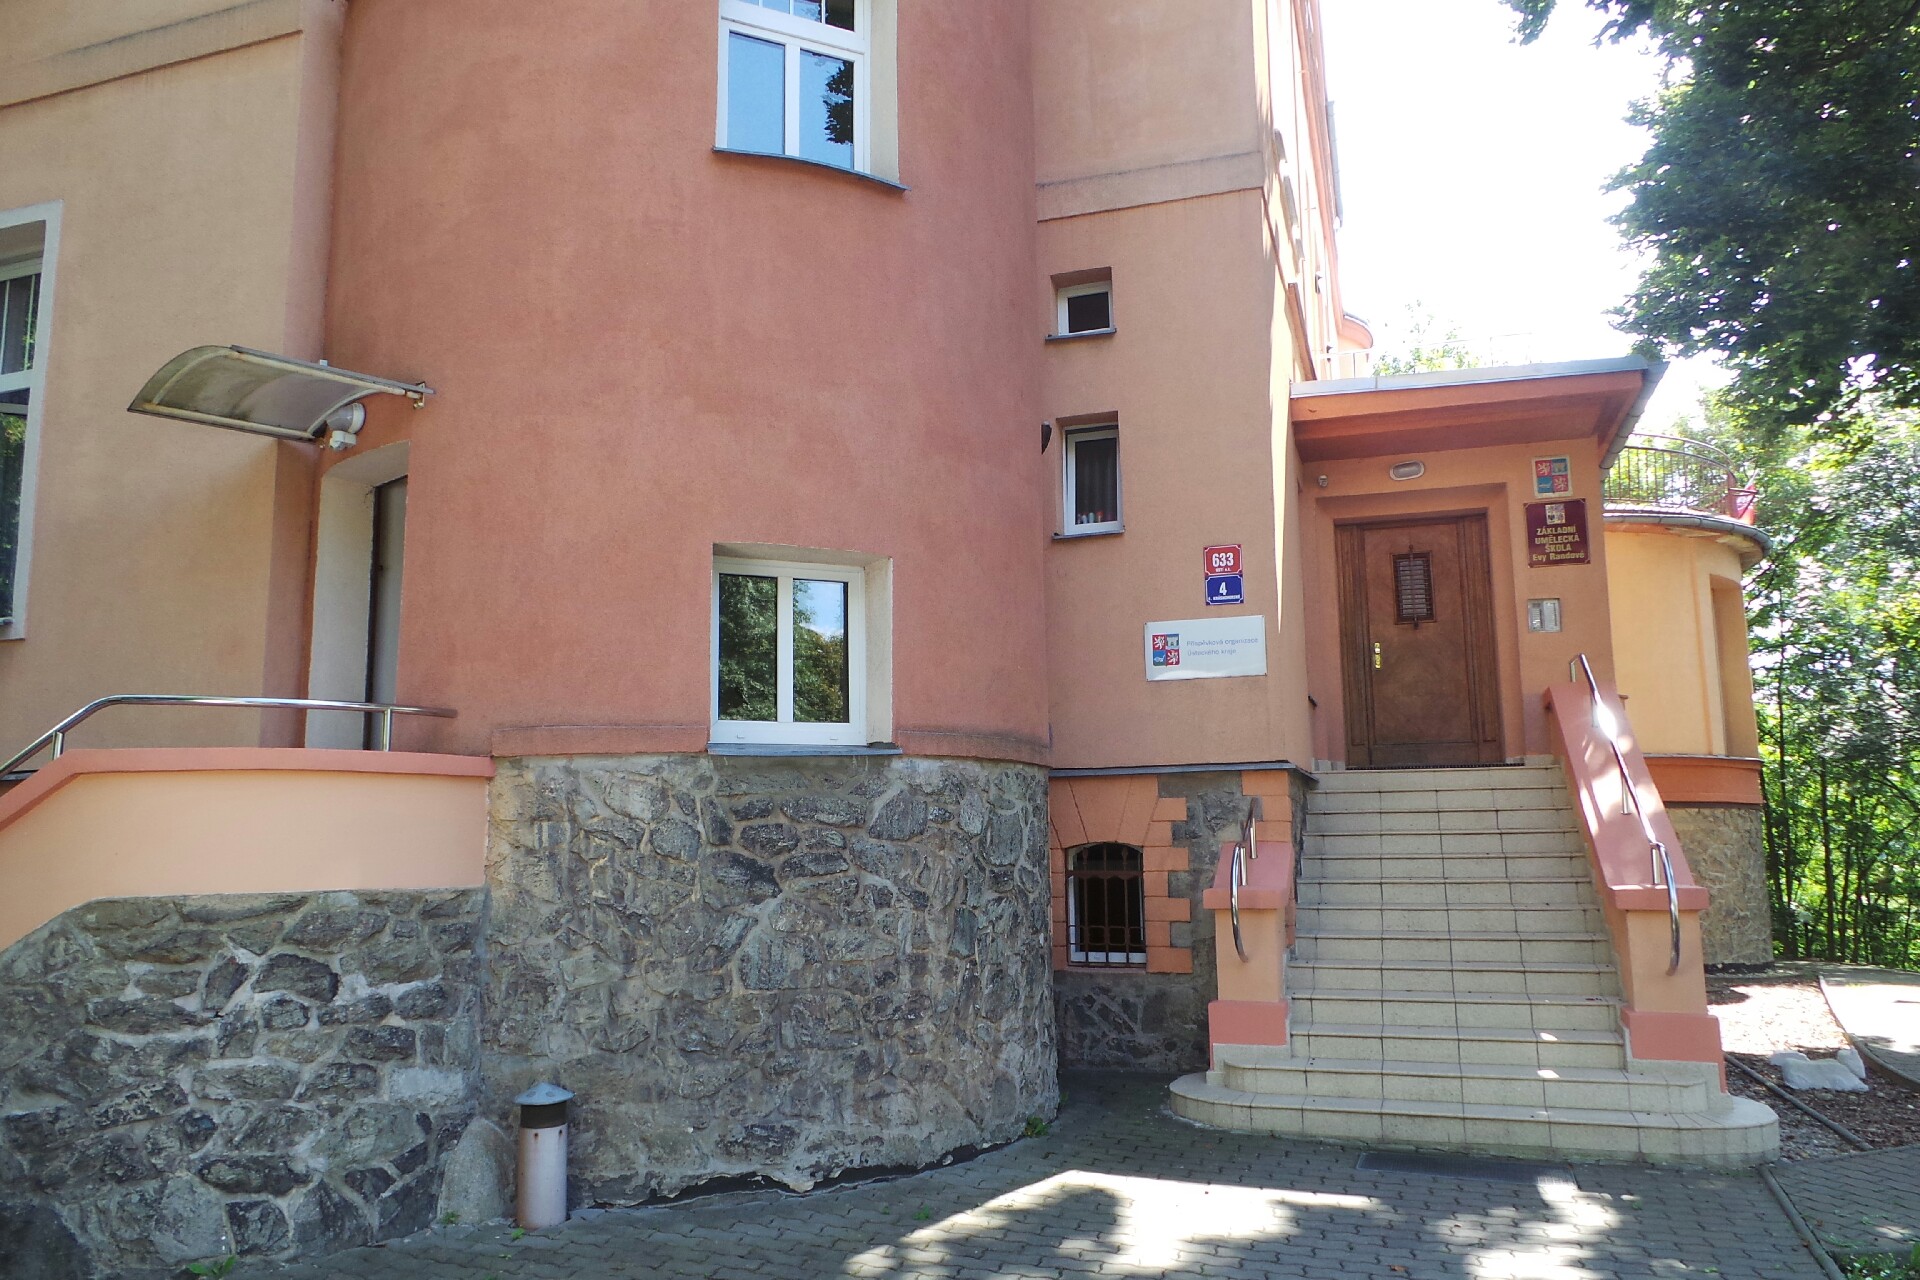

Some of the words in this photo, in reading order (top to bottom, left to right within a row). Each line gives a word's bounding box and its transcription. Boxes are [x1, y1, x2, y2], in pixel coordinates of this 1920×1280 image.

[1536, 525, 1576, 535] ZÁKLADNÍ
[1535, 533, 1579, 544] UMĚLECKÁ
[1545, 543, 1571, 552] ŠKOLA
[1212, 552, 1234, 567] 633
[1532, 554, 1546, 562] Evy
[1550, 551, 1584, 560] Randové
[1219, 582, 1227, 596] 4
[1224, 637, 1258, 645] organizace
[1221, 648, 1236, 656] kraje
